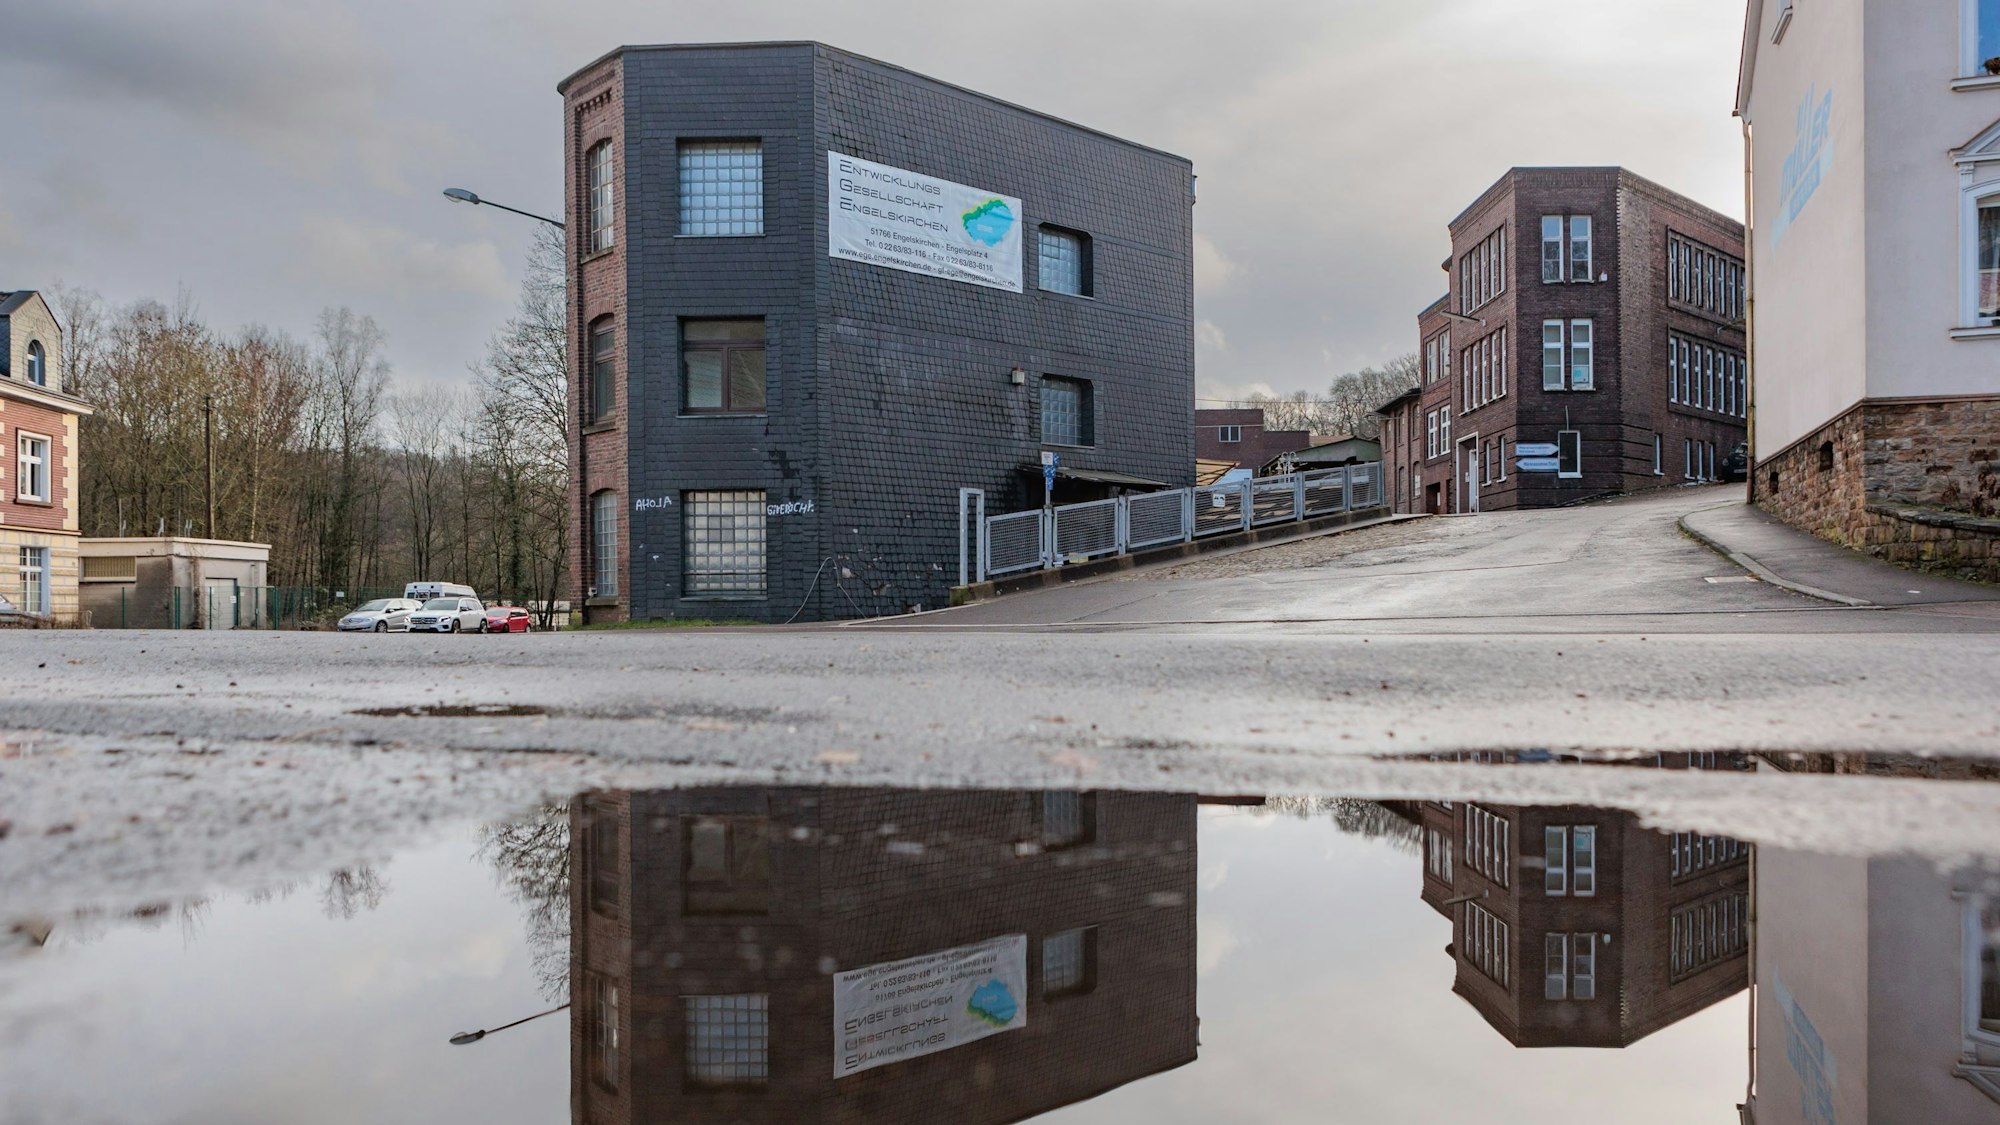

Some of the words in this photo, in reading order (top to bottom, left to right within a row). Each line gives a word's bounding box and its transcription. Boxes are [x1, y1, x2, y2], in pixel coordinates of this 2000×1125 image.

[839, 159, 940, 195] ENTWICKLUNGS
[839, 178, 943, 213] GESELLSCHAFT
[840, 197, 948, 232] ENGELSKIRCHEN
[870, 227, 891, 239] 51766
[892, 232, 939, 249] Engelskirchen
[946, 244, 982, 259] Engelsplatz
[982, 251, 988, 259] 4
[933, 252, 944, 261] Fax
